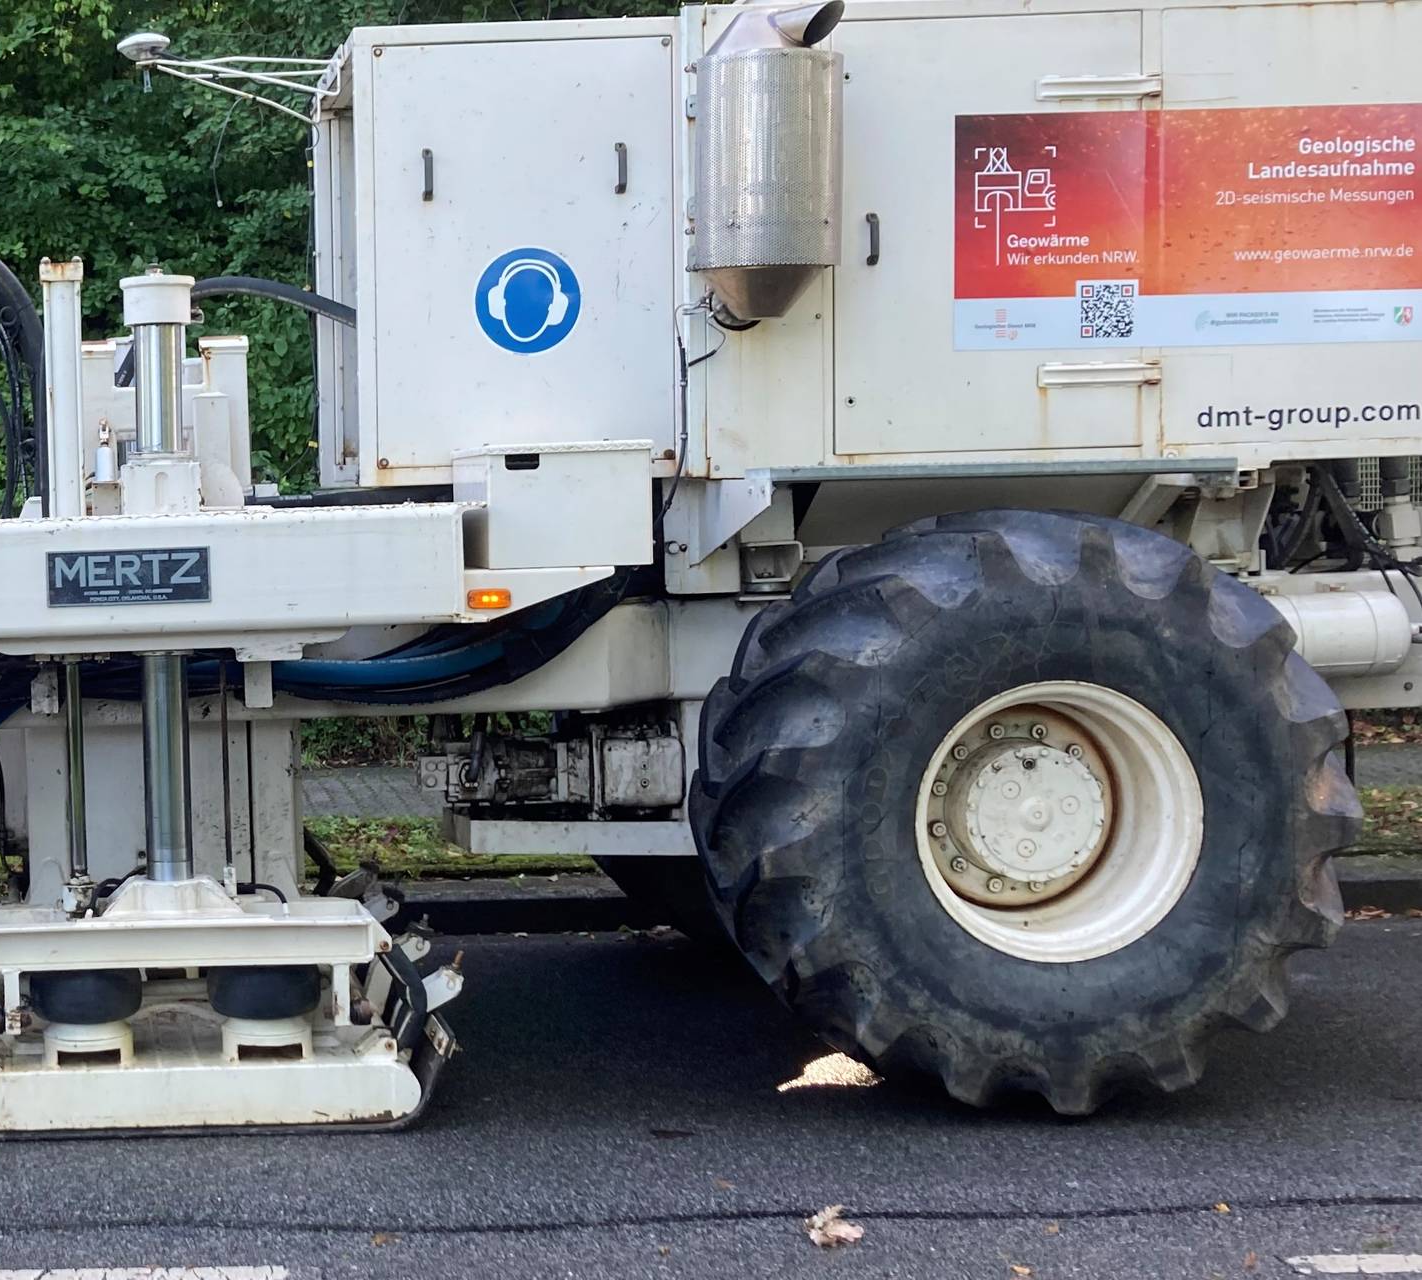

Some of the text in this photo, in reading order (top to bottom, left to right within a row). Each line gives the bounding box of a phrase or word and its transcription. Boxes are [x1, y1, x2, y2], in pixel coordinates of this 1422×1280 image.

[1298, 135, 1416, 157] Geologische
[1248, 159, 1416, 180] Landesaufnahme
[1215, 187, 1415, 206] 2D-seismische Messungen
[1006, 233, 1090, 248] Geowärme
[1006, 250, 1140, 265] Wir erkunden NRW.
[1233, 243, 1414, 264] www.geowaerme.nrw.de
[1197, 403, 1421, 431] dmt-group.com
[54, 552, 202, 589] MERTZ
